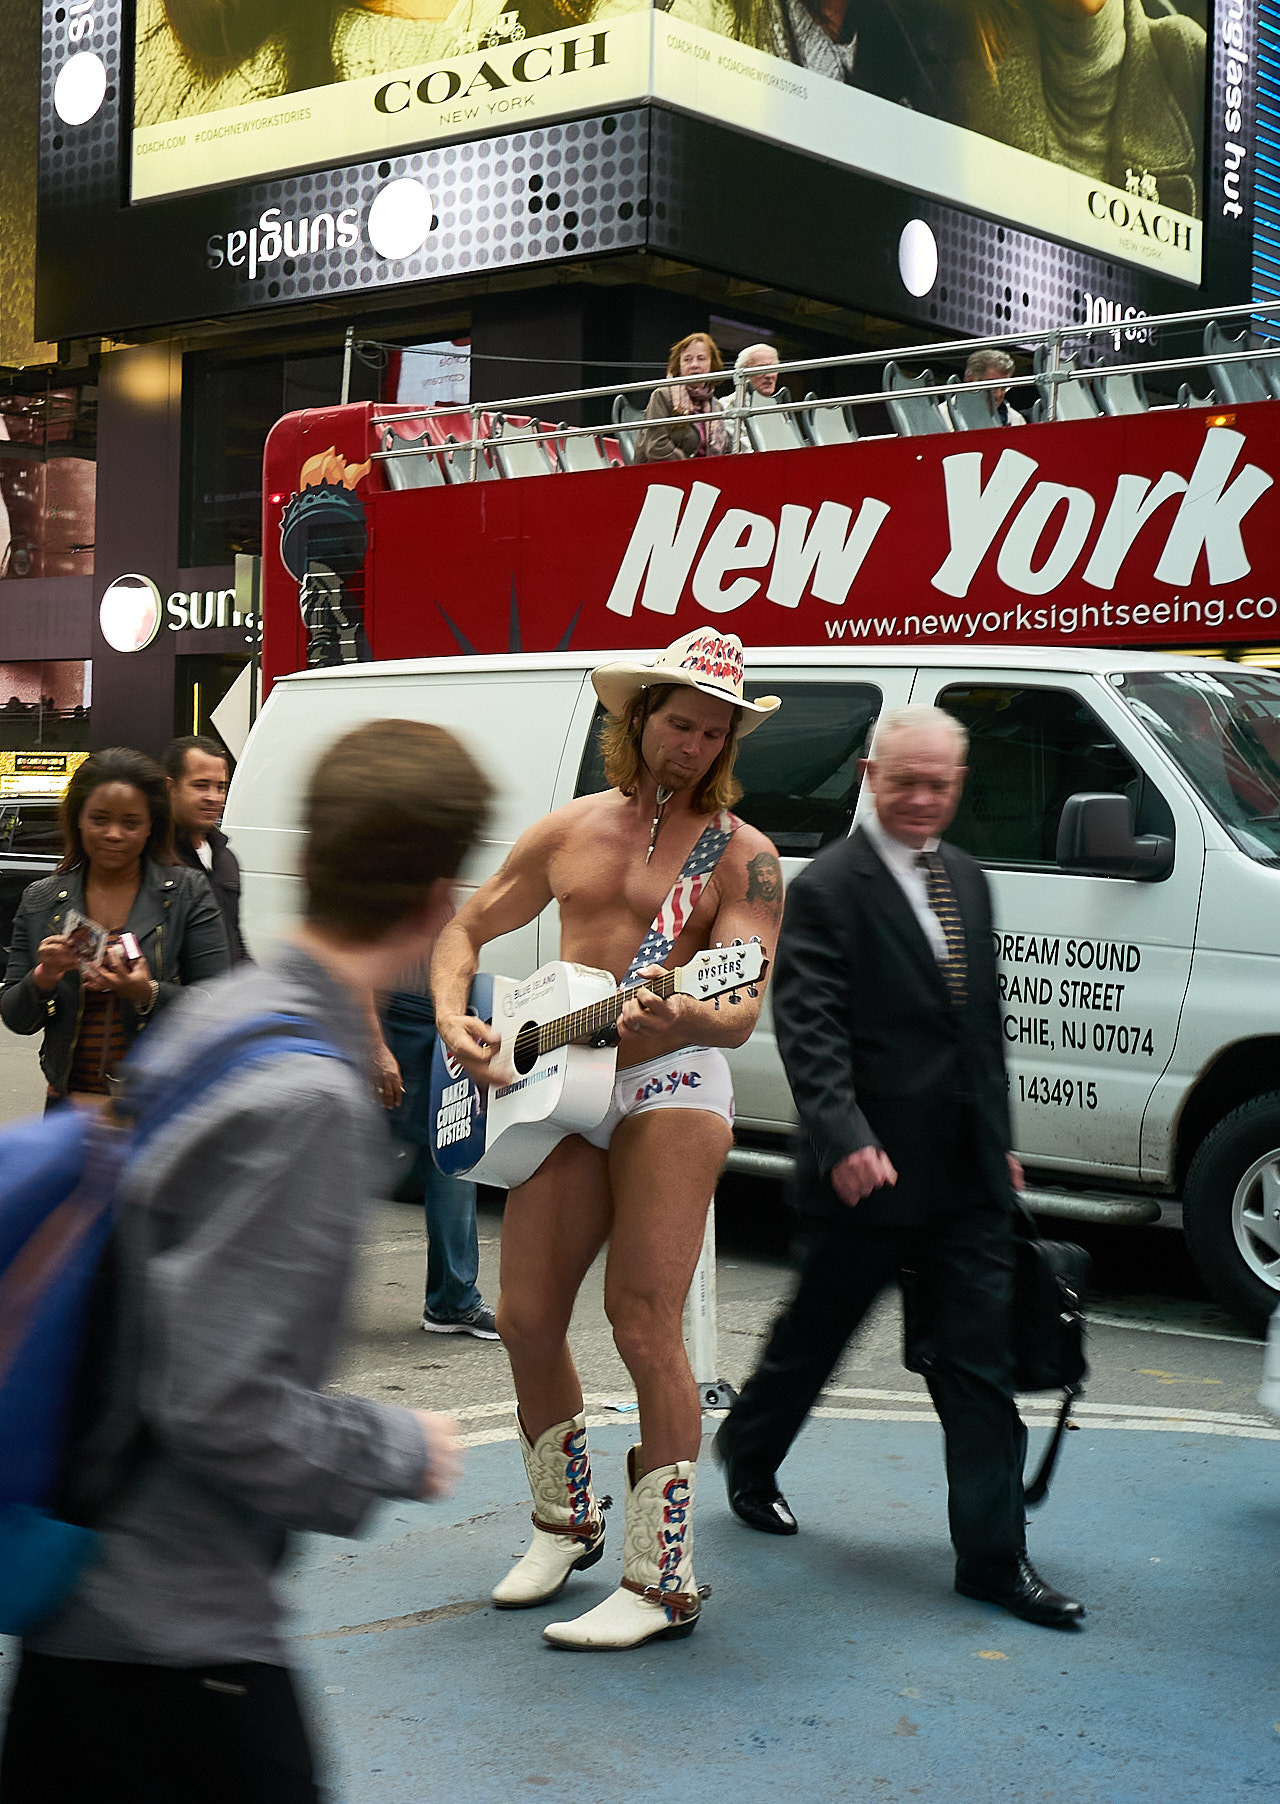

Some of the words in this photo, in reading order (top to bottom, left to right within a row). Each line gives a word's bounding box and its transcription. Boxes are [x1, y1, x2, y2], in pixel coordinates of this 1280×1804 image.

[374, 30, 610, 115] COACH
[439, 108, 480, 126] NEW
[486, 94, 536, 115] YORK
[135, 135, 186, 156] COACH.COM
[194, 107, 312, 144] #COACHNEWYORKSTORIES
[1222, 141, 1246, 219] hut
[1087, 190, 1193, 251] COACH
[606, 481, 891, 618] New
[930, 426, 1274, 597] York
[698, 959, 742, 981] OYSTERS
[1065, 940, 1141, 973] SOUND
[997, 973, 1053, 1005] RAND
[1059, 979, 1125, 1012] STREET
[1003, 1014, 1055, 1051] CHIE,
[1062, 1021, 1086, 1050] NJ
[1093, 1023, 1154, 1057] 07074
[441, 1078, 469, 1108] NAKED
[1019, 1075, 1098, 1110] 1434915
[437, 1095, 473, 1130] COWBOY
[437, 1116, 471, 1149] OYSTERS
